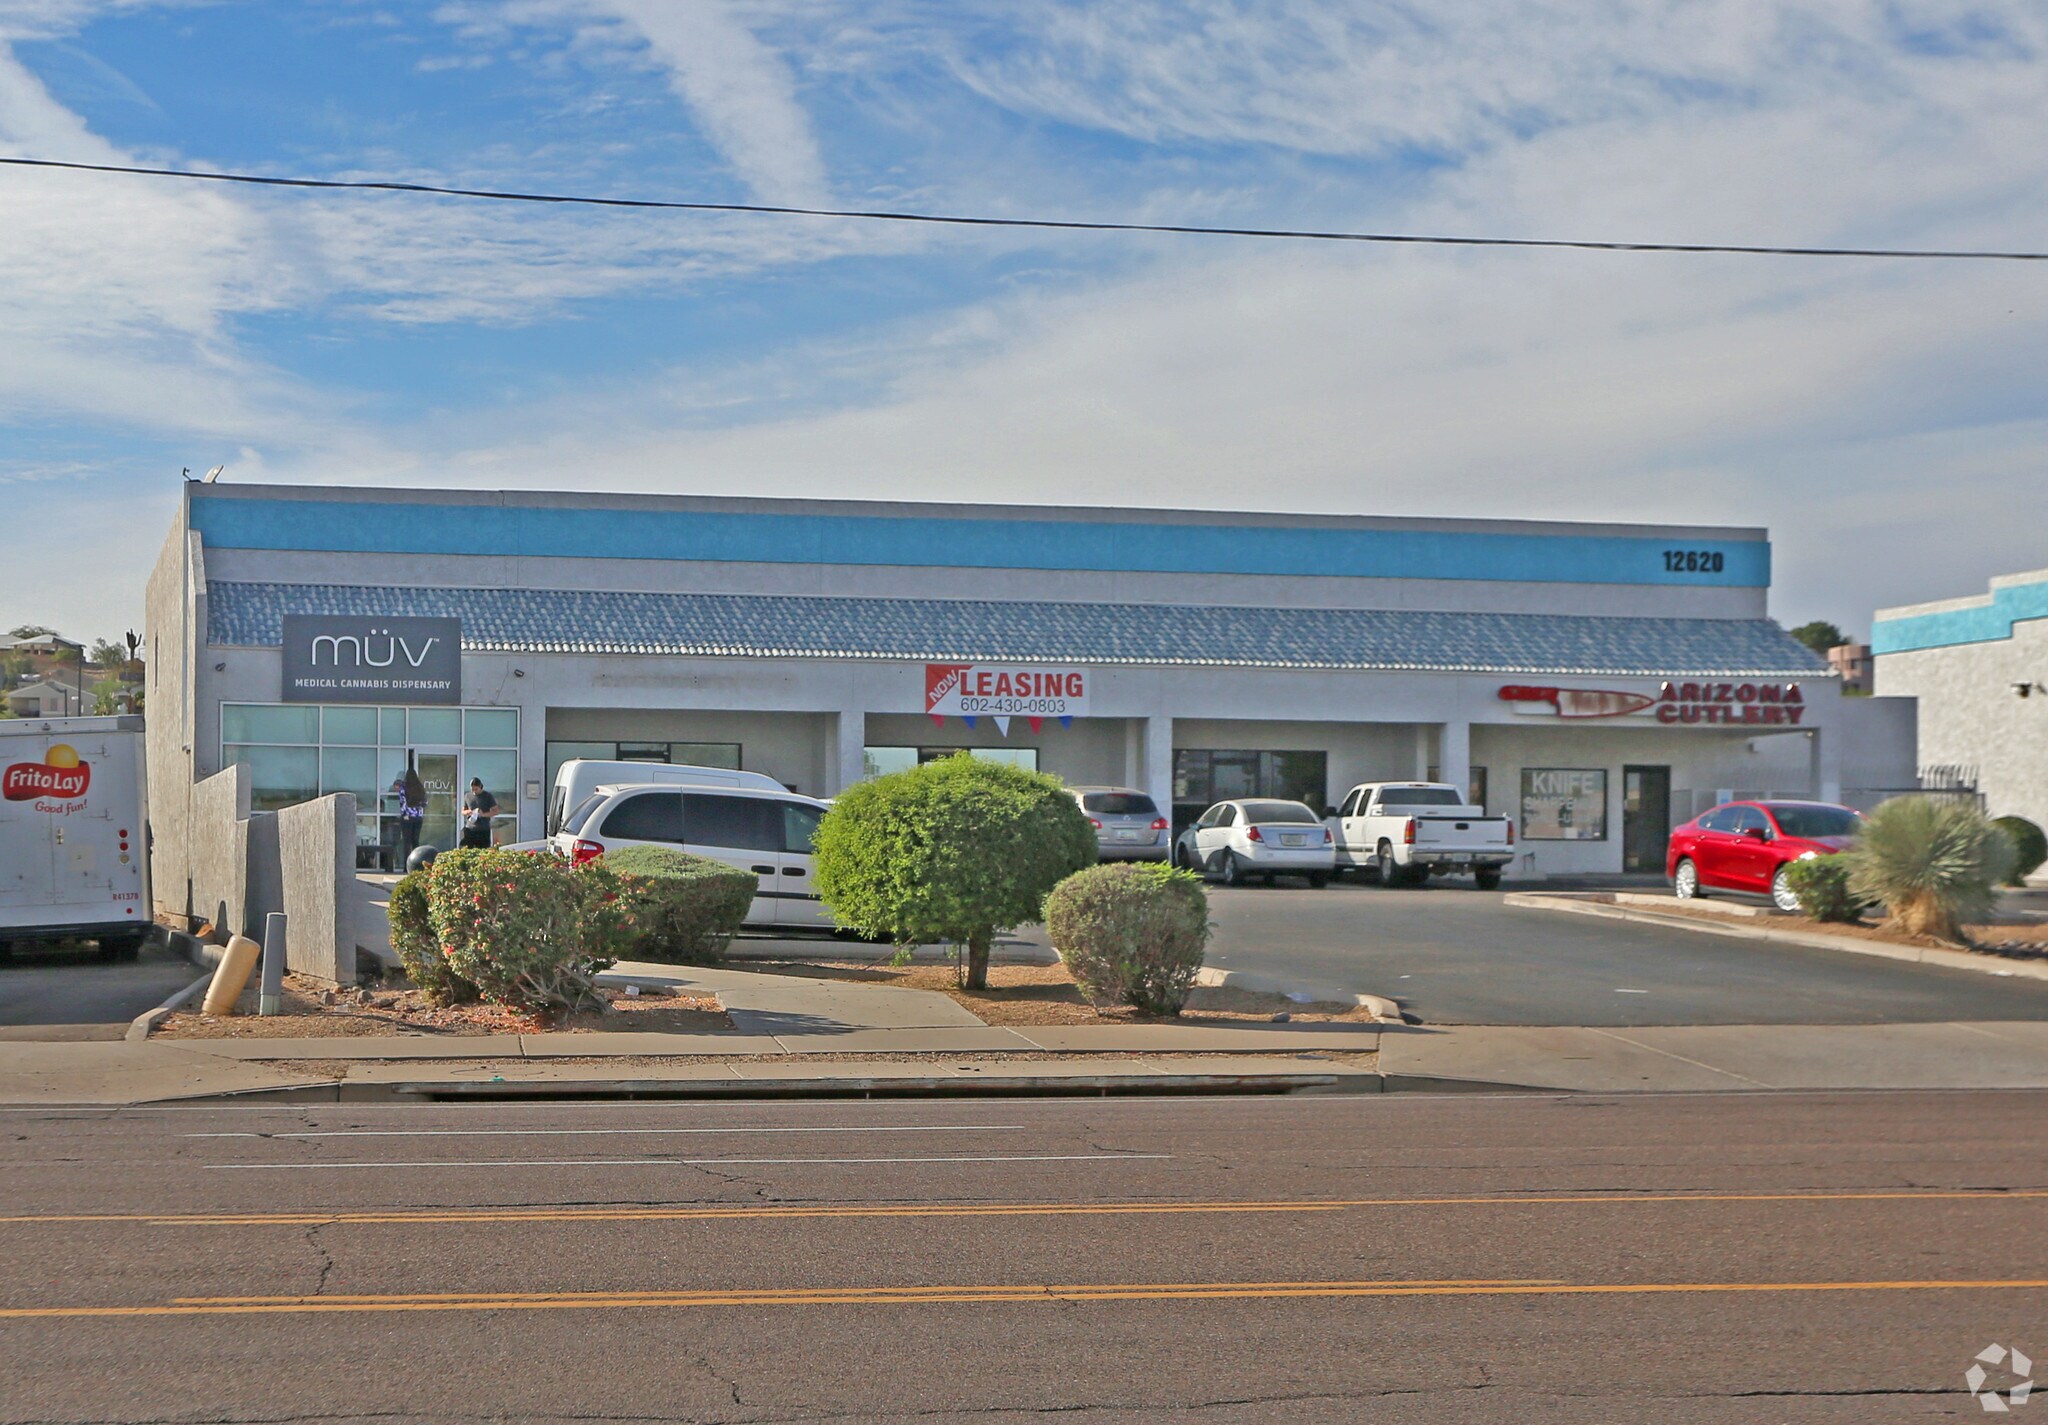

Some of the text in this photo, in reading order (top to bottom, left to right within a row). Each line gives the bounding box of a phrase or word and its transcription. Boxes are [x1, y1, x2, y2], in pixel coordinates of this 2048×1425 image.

[1663, 550, 1724, 572] 12620
[295, 678, 451, 690] MEDICAL CANNABIS DISPENSARY
[928, 669, 958, 703] NOW
[960, 672, 1084, 698] LEASING
[1659, 682, 1804, 703] ARIZONA
[960, 697, 1066, 713] 602-430-0803
[1657, 704, 1806, 724] CUTLERY
[1532, 772, 1594, 794] KNIFE
[35, 799, 88, 816] Good fun!
